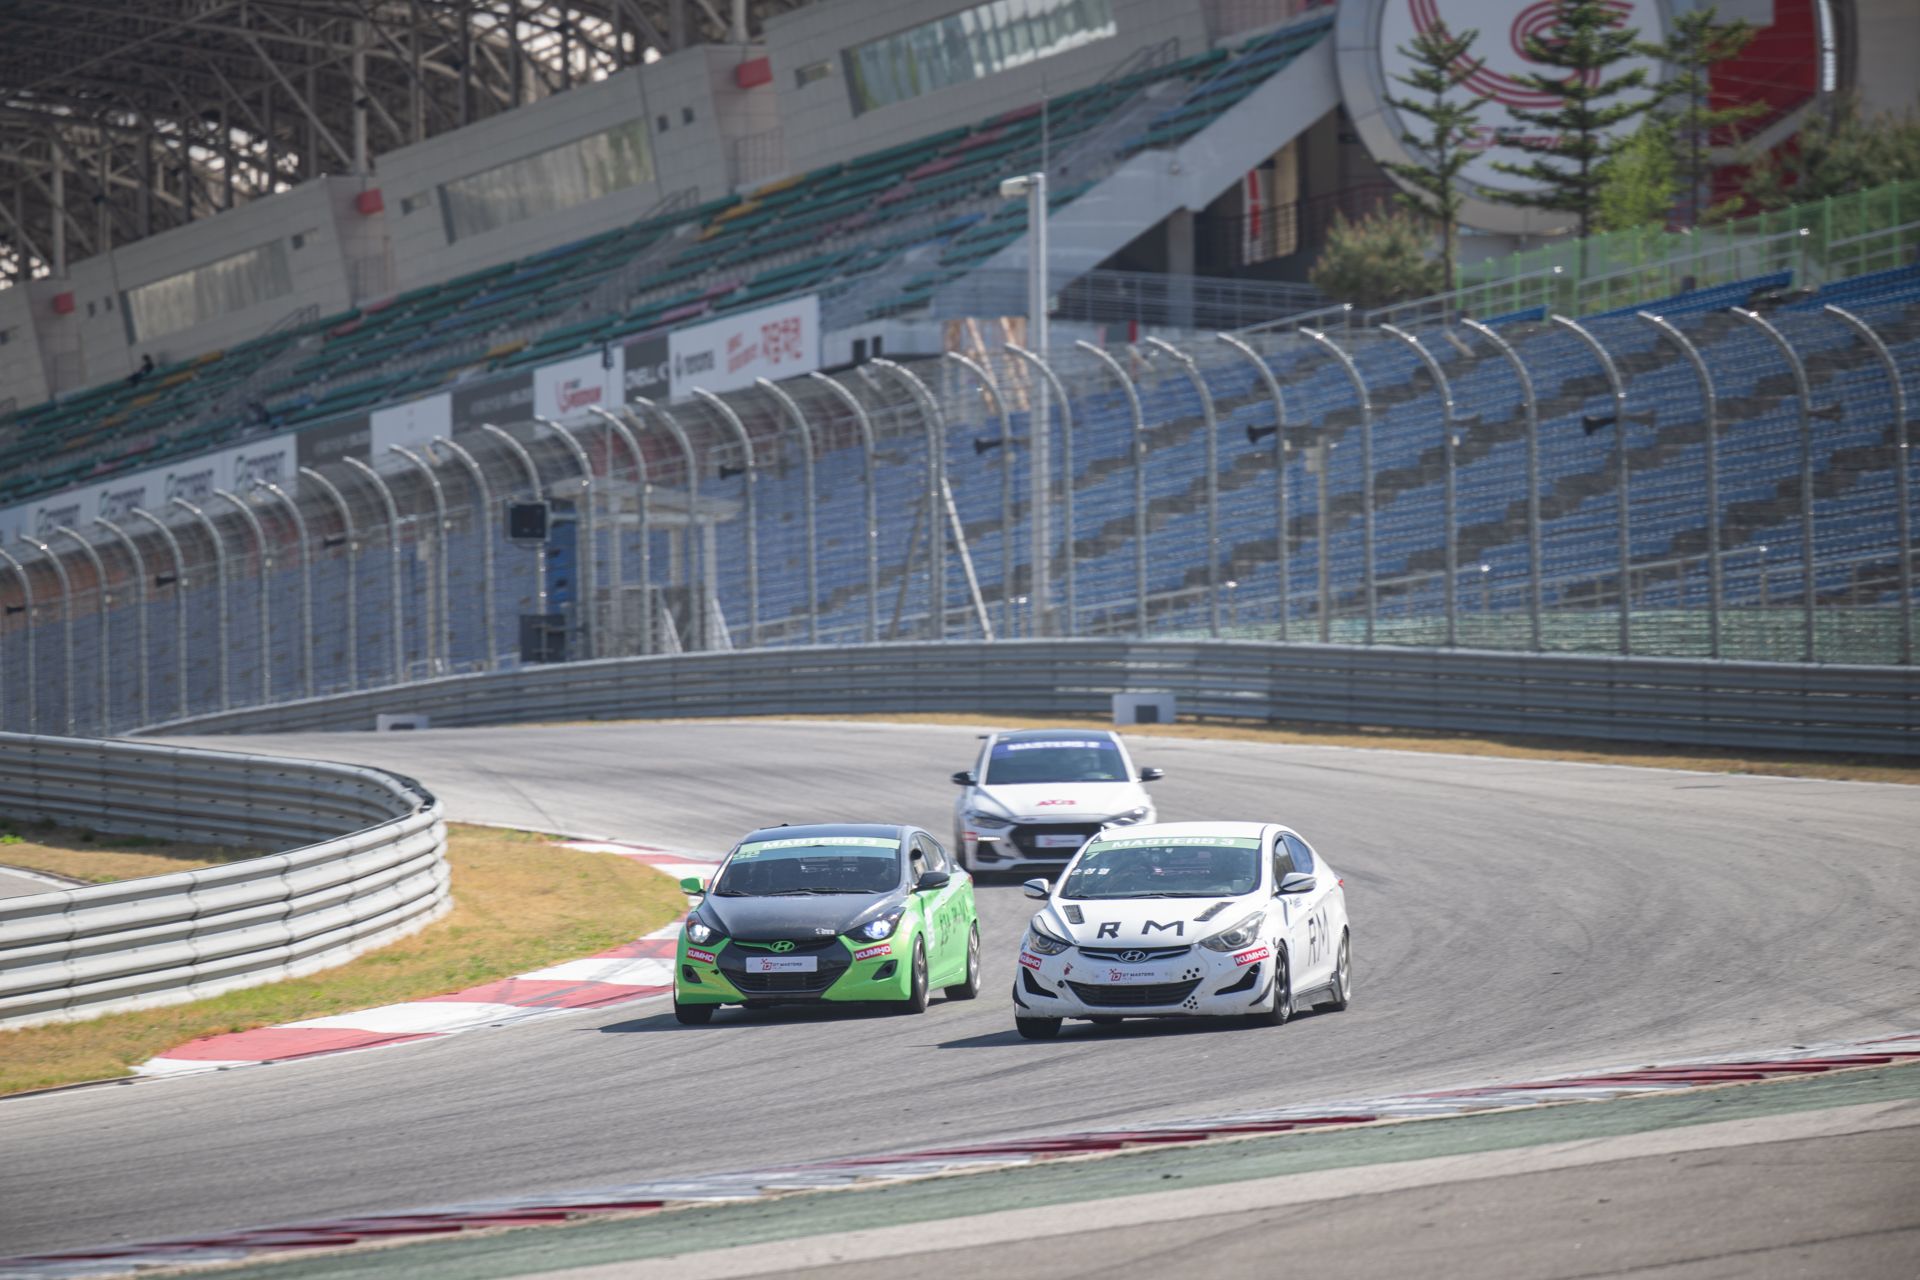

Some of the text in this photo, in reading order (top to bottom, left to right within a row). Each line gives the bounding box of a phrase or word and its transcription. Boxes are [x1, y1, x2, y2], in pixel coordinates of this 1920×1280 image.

[762, 836, 859, 849] MASTERS
[1111, 837, 1236, 849] MASTERS 3
[687, 949, 715, 963] KUMHO
[856, 945, 890, 960] KUMHO
[1235, 948, 1269, 964] KUMHO
[1020, 954, 1041, 968] KUMHO
